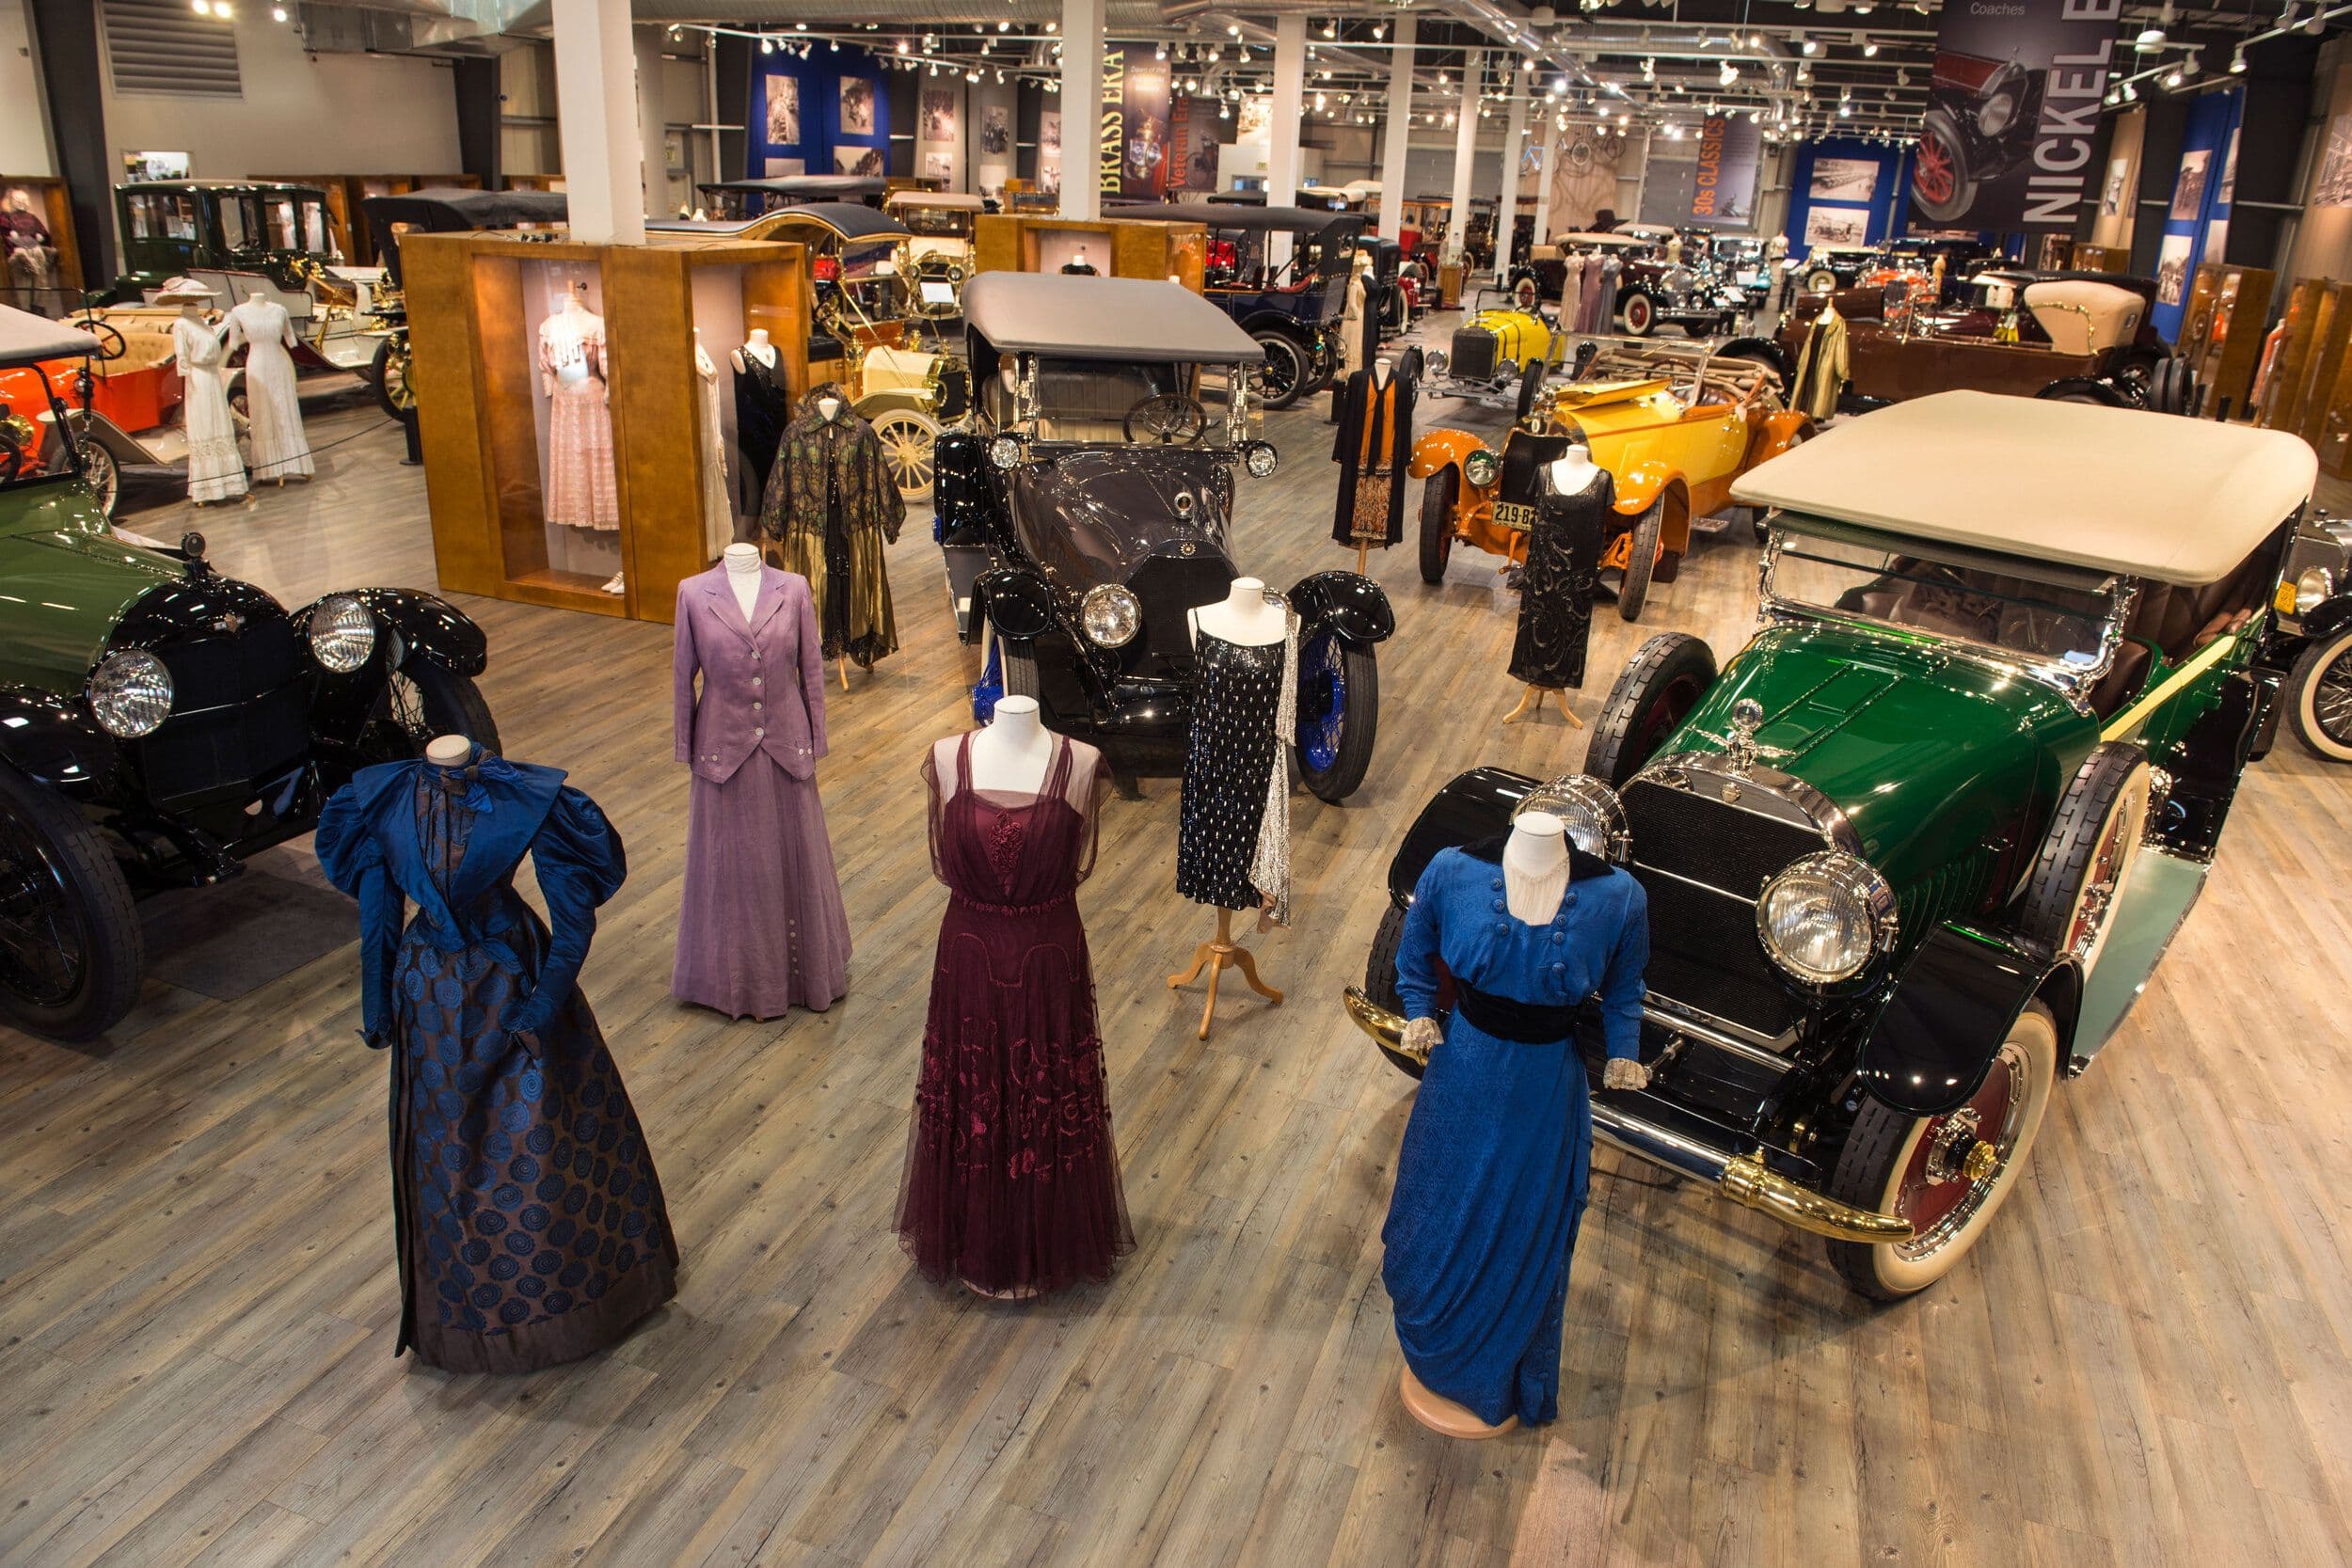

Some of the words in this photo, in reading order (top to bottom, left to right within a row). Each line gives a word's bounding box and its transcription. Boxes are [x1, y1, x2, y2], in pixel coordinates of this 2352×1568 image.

[1970, 2, 2026, 15] Coaches
[1102, 49, 1124, 105] ERA
[1101, 112, 1123, 195] BRASS
[1170, 124, 1188, 188] Veteran
[1697, 119, 1725, 187] CLASSICS
[2023, 39, 2113, 222] NICKEL
[1692, 189, 1716, 215] 30s
